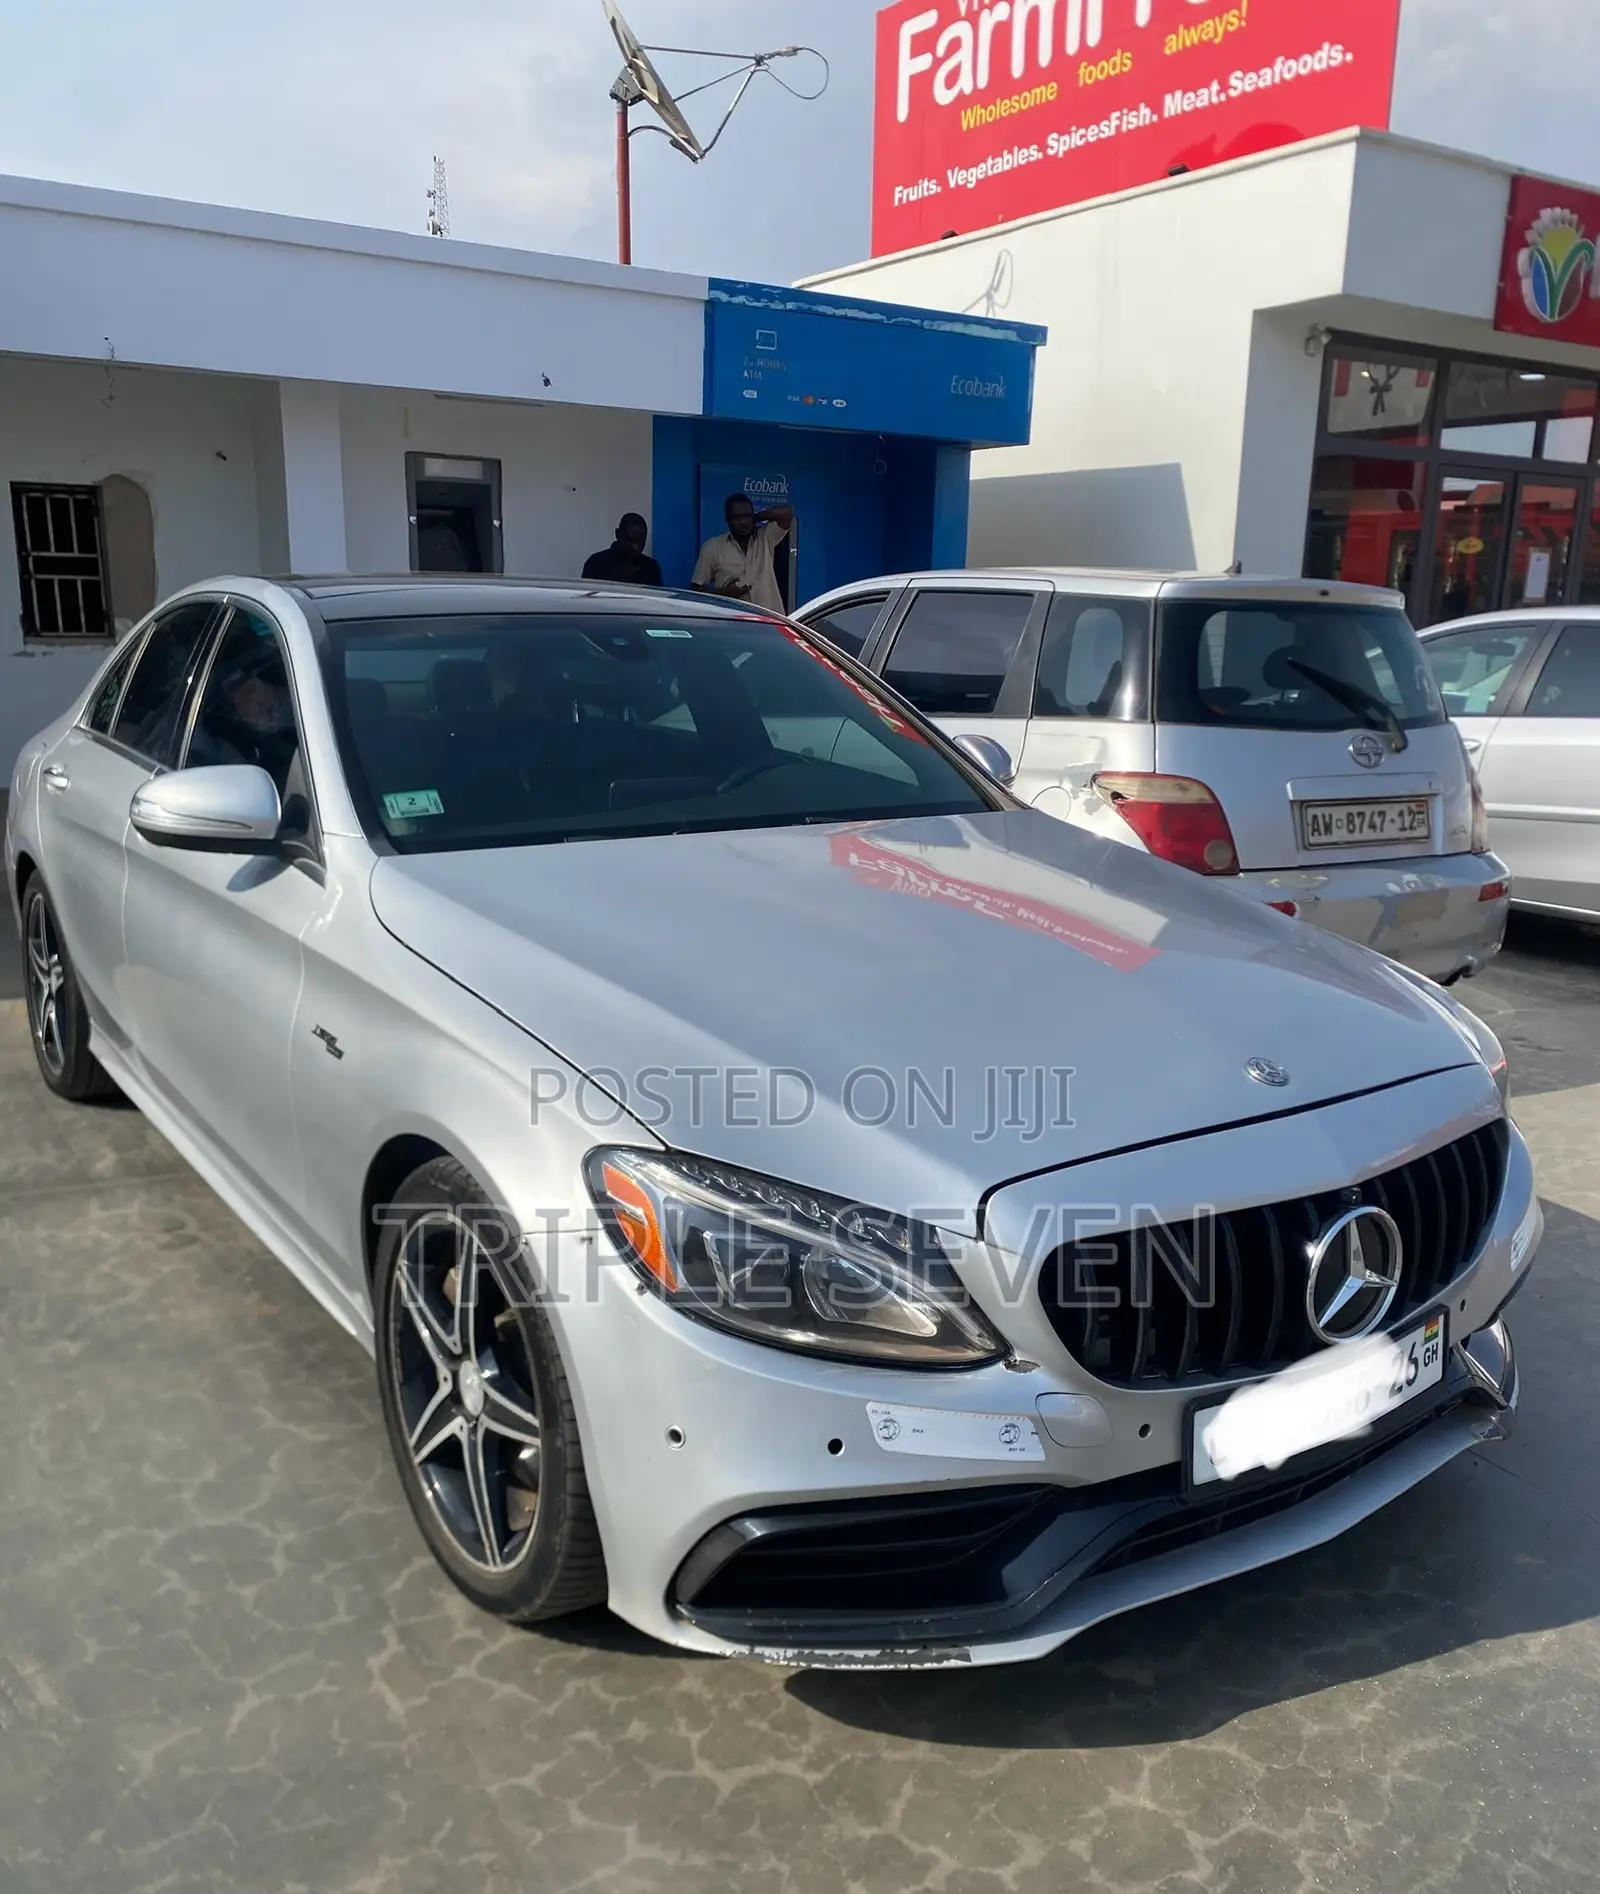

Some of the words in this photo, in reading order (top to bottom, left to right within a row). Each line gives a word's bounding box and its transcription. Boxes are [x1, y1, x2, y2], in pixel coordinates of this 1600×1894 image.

[960, 82, 1058, 131] Wholesome
[1078, 48, 1133, 87] foods
[1164, 0, 1249, 55] always!
[893, 177, 942, 206] Fruits.
[946, 144, 1043, 189] Vegetables.
[950, 371, 1007, 397] Ecobank
[743, 474, 789, 494] Ecobank
[1310, 813, 1333, 837] AW
[1424, 1342, 1439, 1368] GH
